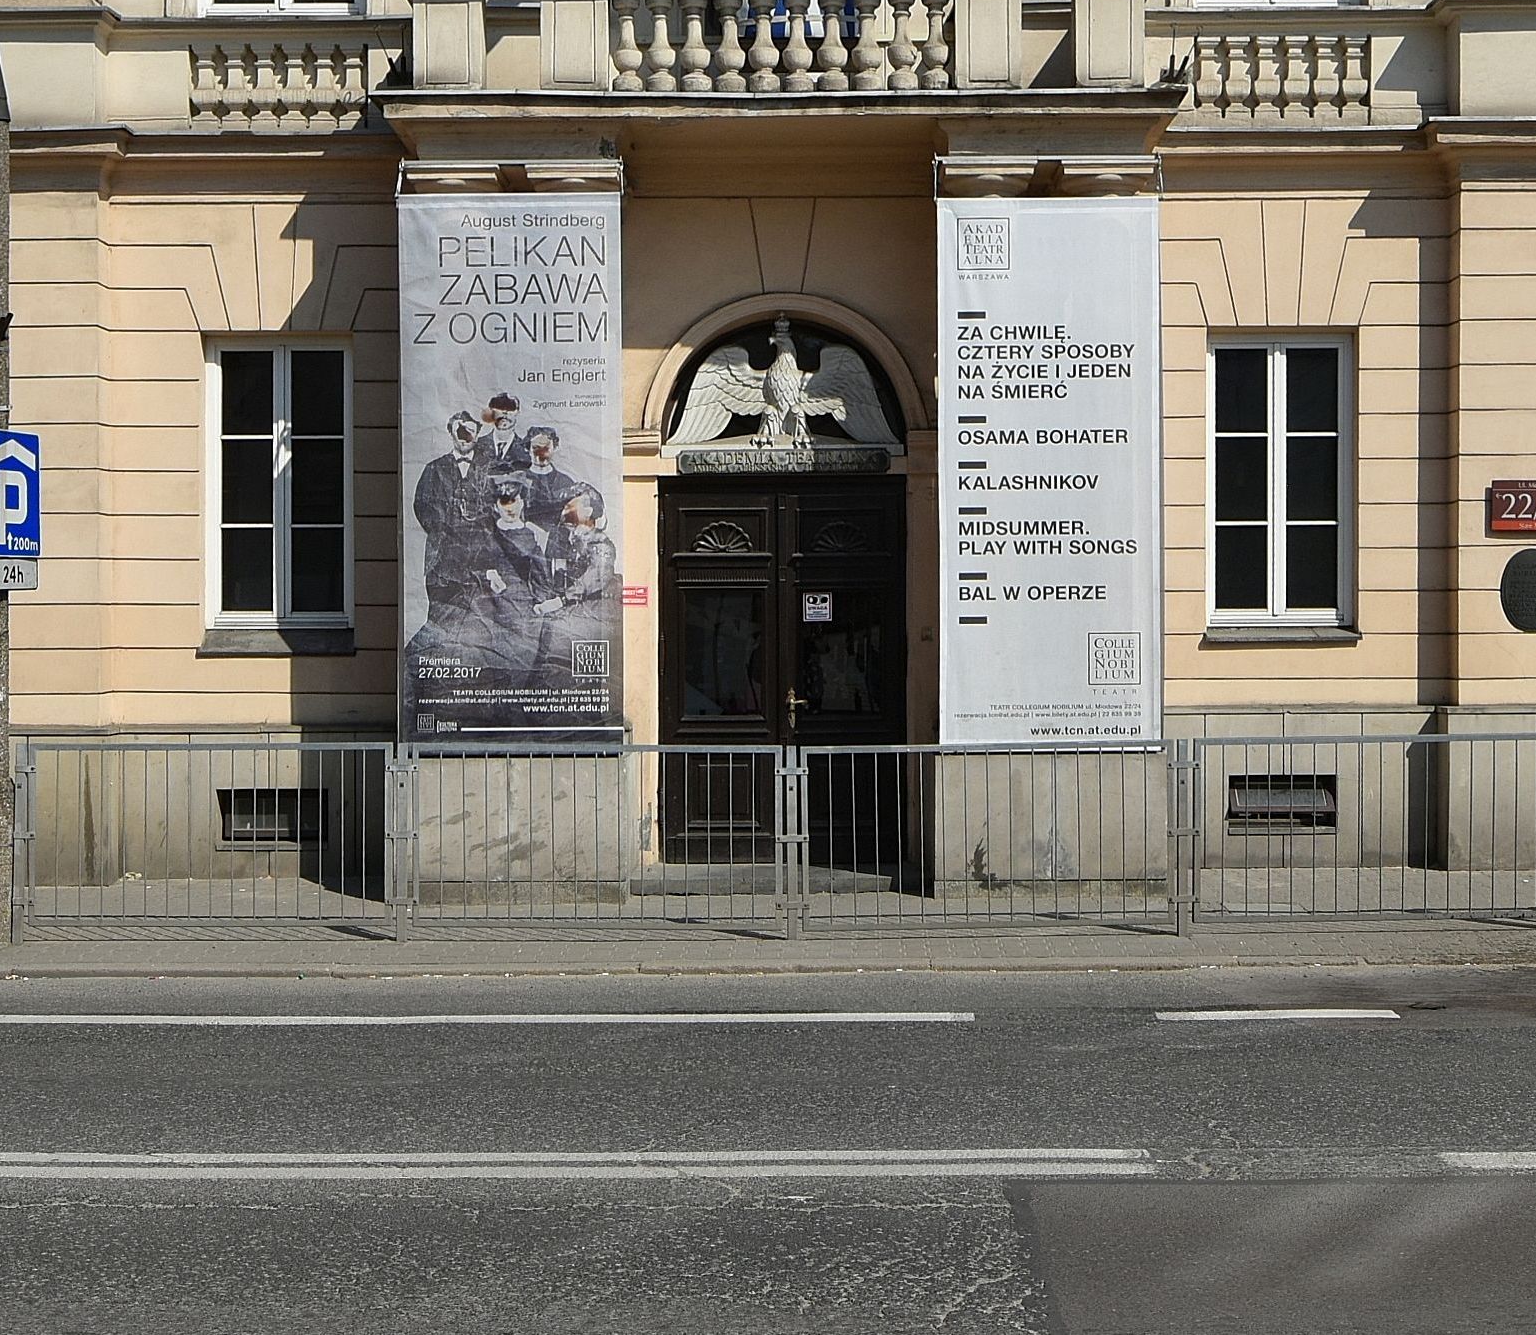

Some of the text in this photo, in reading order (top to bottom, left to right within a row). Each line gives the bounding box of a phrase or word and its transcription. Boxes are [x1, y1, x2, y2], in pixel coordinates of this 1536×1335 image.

[461, 213, 605, 230] August Strindberg
[963, 223, 1004, 234] AKAD
[964, 235, 1004, 244] EMIA
[438, 235, 606, 268] PELIKAN
[963, 243, 1004, 254] TEATR
[963, 255, 1004, 265] ALNA
[958, 273, 1010, 281] WARSZAWA
[439, 273, 609, 306] ZABAWA
[413, 311, 609, 345] Z OGNIEM
[957, 325, 1072, 344] ZA CHWILĘ.
[957, 343, 1135, 360] CZTERY SPOSOBY
[562, 356, 606, 367] reżyseria
[517, 369, 607, 385] Jan Englert
[957, 361, 1131, 379] NA ŻYCIE I JEDEN
[957, 380, 1068, 399] NA ŚMIERĆ
[532, 399, 607, 409] Zygmunt Łanowski
[957, 429, 1129, 445] OSAMA BOHATER
[786, 451, 878, 465] TEATRALN
[958, 475, 1099, 490] KALASHNIKOV
[958, 521, 1091, 536] MIDSUMMER.
[13, 537, 39, 551] 200m
[958, 539, 1138, 556] PLAY WITH SONGS
[3, 565, 24, 584] 24h
[959, 585, 1107, 601] BAL W OPERZE
[1094, 637, 1135, 649] COLLE
[1094, 649, 1134, 659] GIUM
[418, 657, 461, 666] Premiera
[1095, 659, 1134, 670] NOBI
[418, 667, 482, 679] 27.02.2017
[1095, 670, 1134, 679] LIUM
[523, 703, 609, 713] www.tcn.at.edu.pl
[1030, 725, 1141, 737] www.tcn.at.edu.pl
